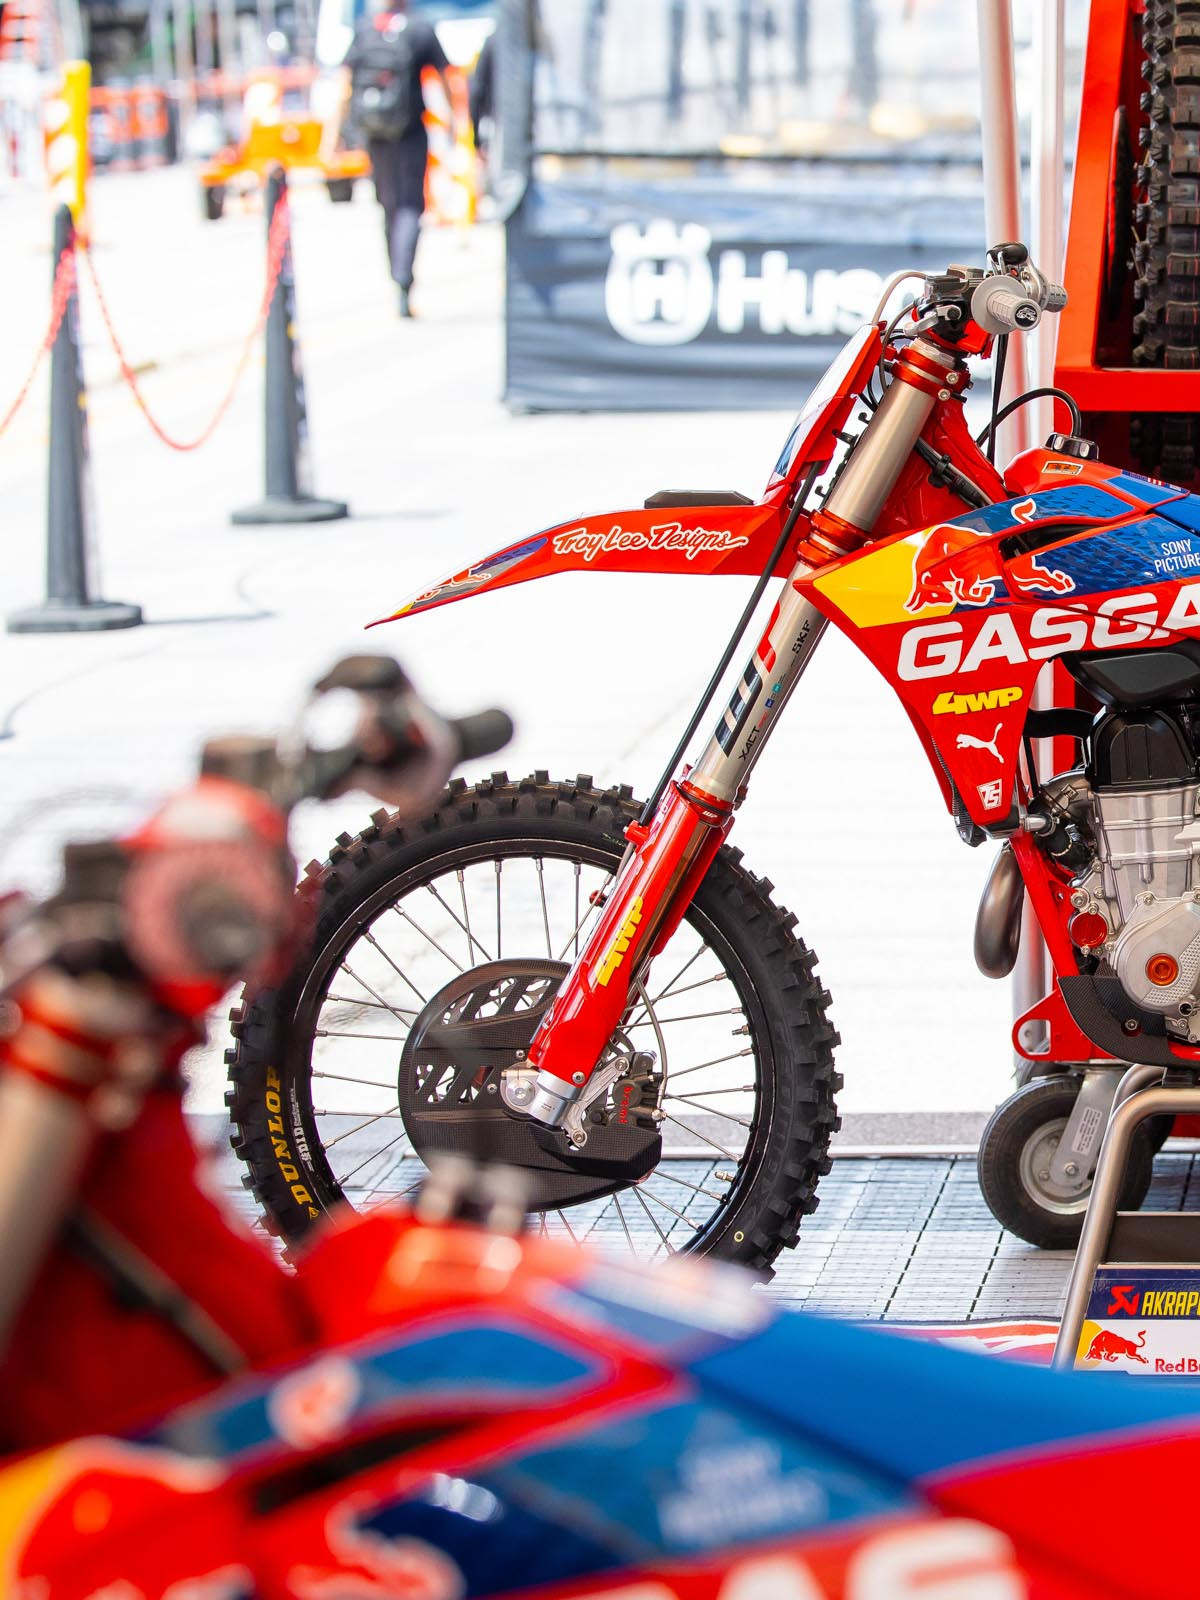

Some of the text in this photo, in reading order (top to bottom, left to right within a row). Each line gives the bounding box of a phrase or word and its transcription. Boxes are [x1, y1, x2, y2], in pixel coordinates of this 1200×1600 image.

[553, 522, 749, 561] Troy Lee Designs
[1161, 539, 1192, 556] SONY
[791, 619, 811, 655] SKF
[932, 684, 1023, 715] 4WP
[738, 726, 761, 761] XACT
[265, 1066, 313, 1205] DUNLOP
[1155, 1358, 1185, 1373] Red
